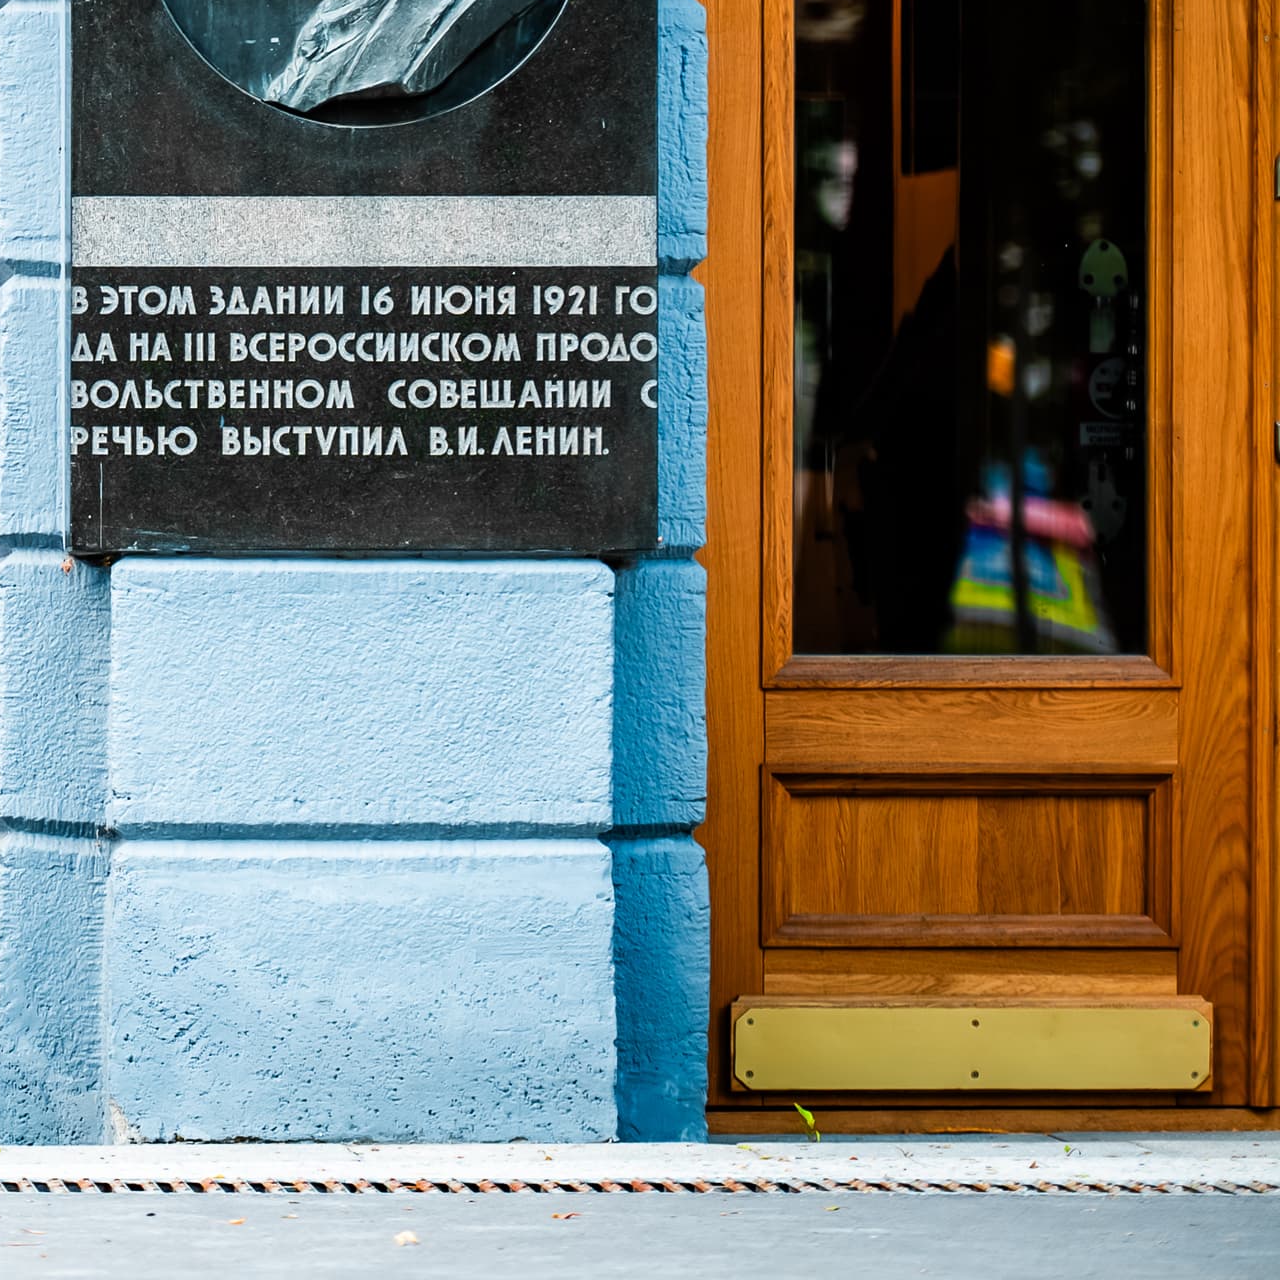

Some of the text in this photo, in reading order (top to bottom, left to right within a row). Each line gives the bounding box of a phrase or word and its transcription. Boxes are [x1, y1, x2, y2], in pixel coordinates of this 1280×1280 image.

[71, 285, 658, 315] В ЭТОМ ЗДАНИИ 16 ИЮНЯ 1921 ГО
[71, 332, 118, 362] ДА
[130, 332, 173, 362] НА
[184, 333, 216, 362] III
[536, 332, 658, 362] ПРОДО
[71, 379, 658, 409] ВОЛЬСТВЕННОМ СОВЕЩАНИИ С
[70, 426, 198, 456] РЕЧЬЮ
[222, 426, 408, 456] ВЫСТУПИЛ
